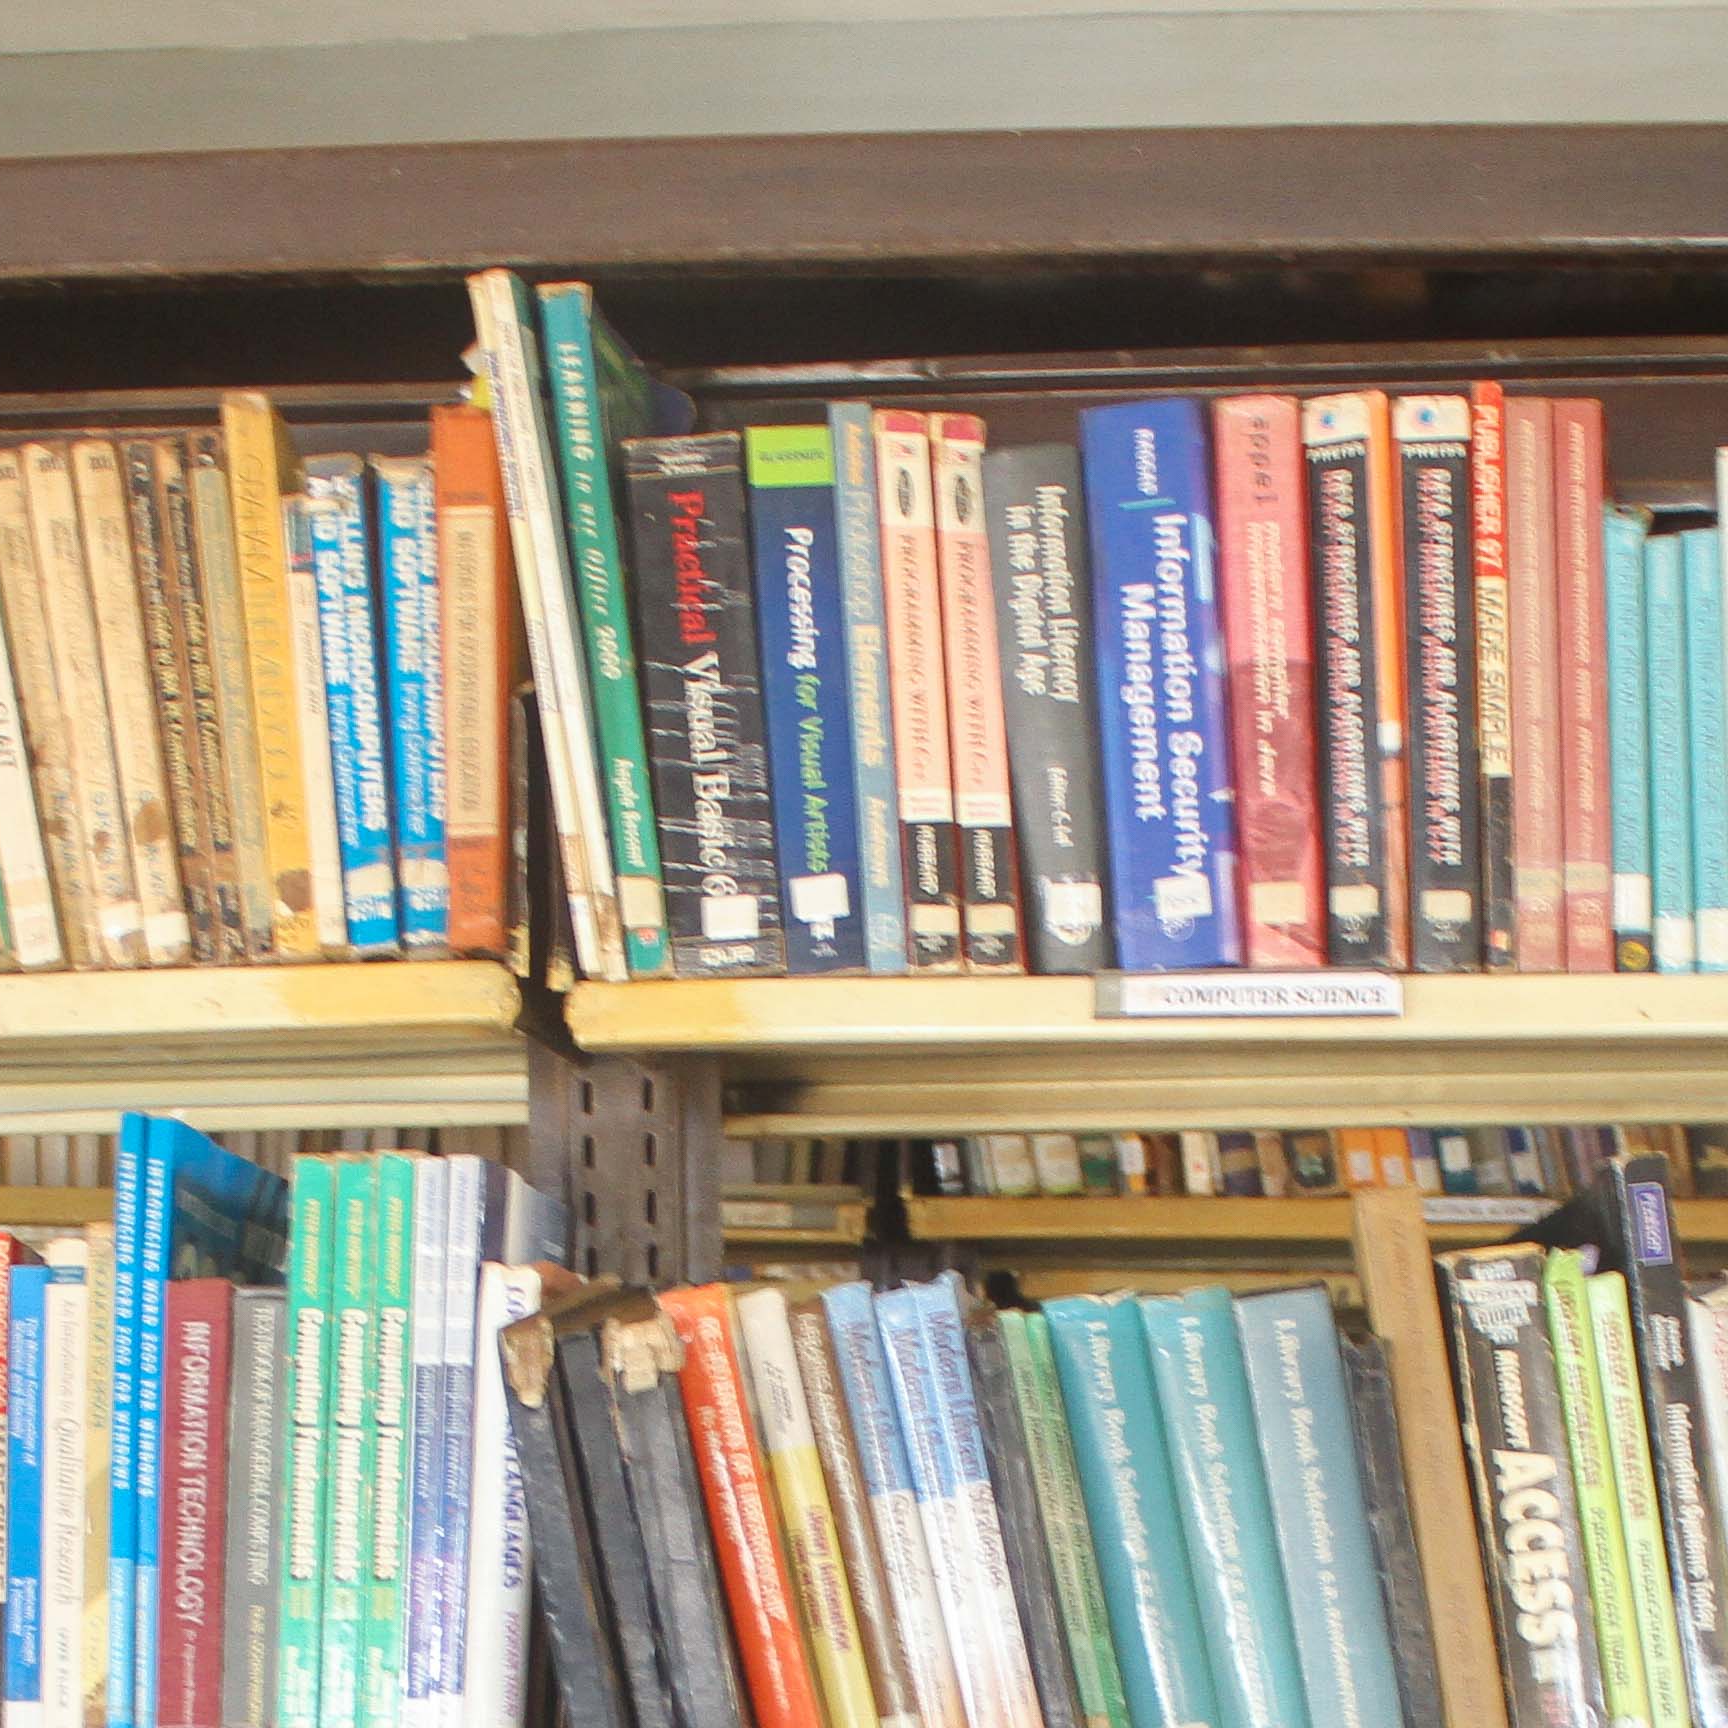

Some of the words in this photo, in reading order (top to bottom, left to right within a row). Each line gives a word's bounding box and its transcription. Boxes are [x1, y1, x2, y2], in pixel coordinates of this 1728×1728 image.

[555, 340, 597, 462] LEARNING
[1470, 404, 1504, 534] PUBLISHER
[666, 487, 718, 645] Practical
[773, 524, 824, 670] Processing
[1004, 572, 1044, 648] Digital
[1034, 483, 1078, 614] Information
[1042, 616, 1083, 704] Literacy
[1145, 510, 1208, 722] Information
[677, 649, 729, 767] Visual
[794, 672, 820, 712] for
[795, 715, 830, 791] Visual
[854, 624, 890, 765] Elements
[1103, 580, 1182, 821] Management
[690, 771, 737, 870] Basic
[799, 792, 835, 873] Artists
[1156, 730, 1216, 879] Security
[1162, 986, 1290, 1008] COMPUTER
[1295, 984, 1388, 1006] SCIENCE
[177, 1321, 210, 1469] INFORMATION
[174, 1475, 207, 1625] TECHNOLOGY
[1493, 1448, 1579, 1648] ACCESS
